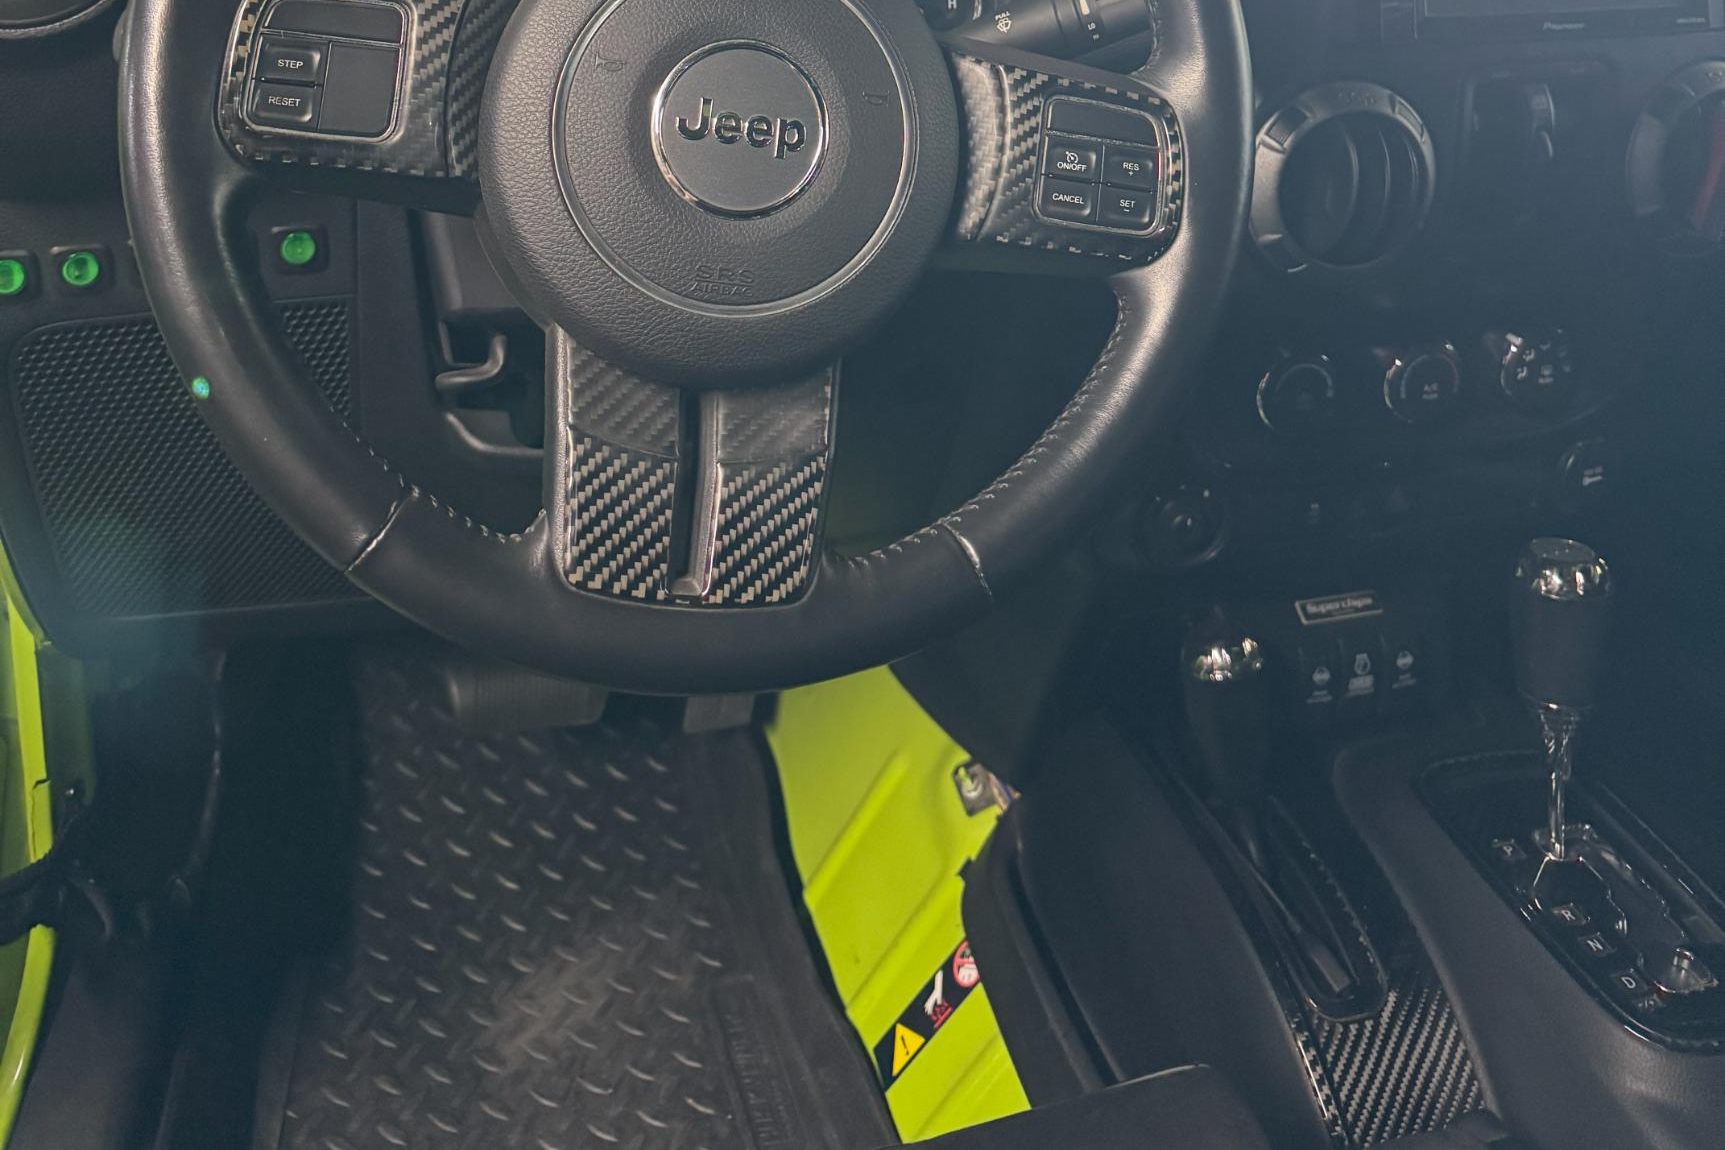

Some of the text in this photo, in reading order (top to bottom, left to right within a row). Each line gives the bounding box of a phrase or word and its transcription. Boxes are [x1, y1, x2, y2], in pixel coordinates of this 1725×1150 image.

[994, 11, 1011, 21] PULL
[277, 59, 304, 69] STEP
[268, 96, 302, 107] RESET
[675, 97, 807, 159] Jeep
[1056, 161, 1088, 172] ON/OFF
[1122, 162, 1140, 171] RES
[1052, 193, 1085, 204] CANCEL
[1119, 199, 1136, 208] SET
[696, 264, 754, 284] SRS
[1561, 909, 1575, 921] R
[1586, 938, 1603, 952] N
[1621, 976, 1636, 989] D
